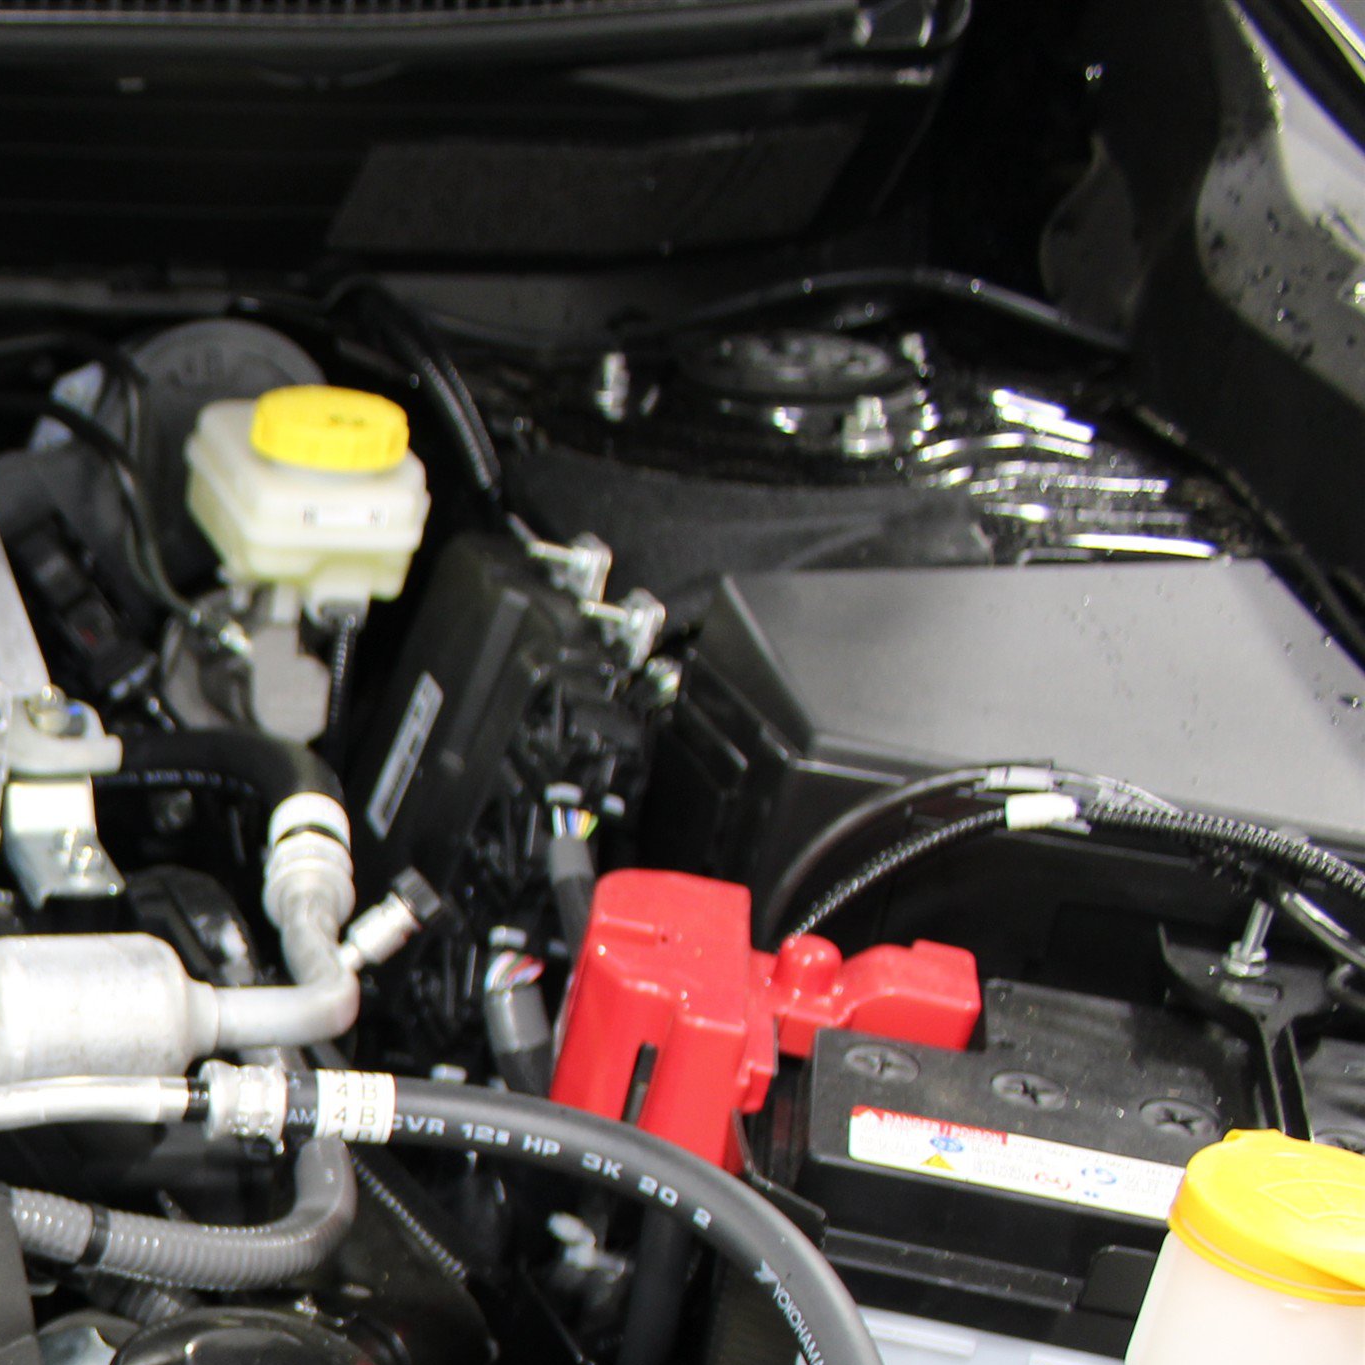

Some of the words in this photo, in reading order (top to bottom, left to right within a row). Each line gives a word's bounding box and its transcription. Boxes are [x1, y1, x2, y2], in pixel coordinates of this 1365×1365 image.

[392, 1114, 446, 1136] CVR
[522, 1134, 561, 1156] HP
[582, 1152, 625, 1180] 3K
[637, 1174, 680, 1208] 20
